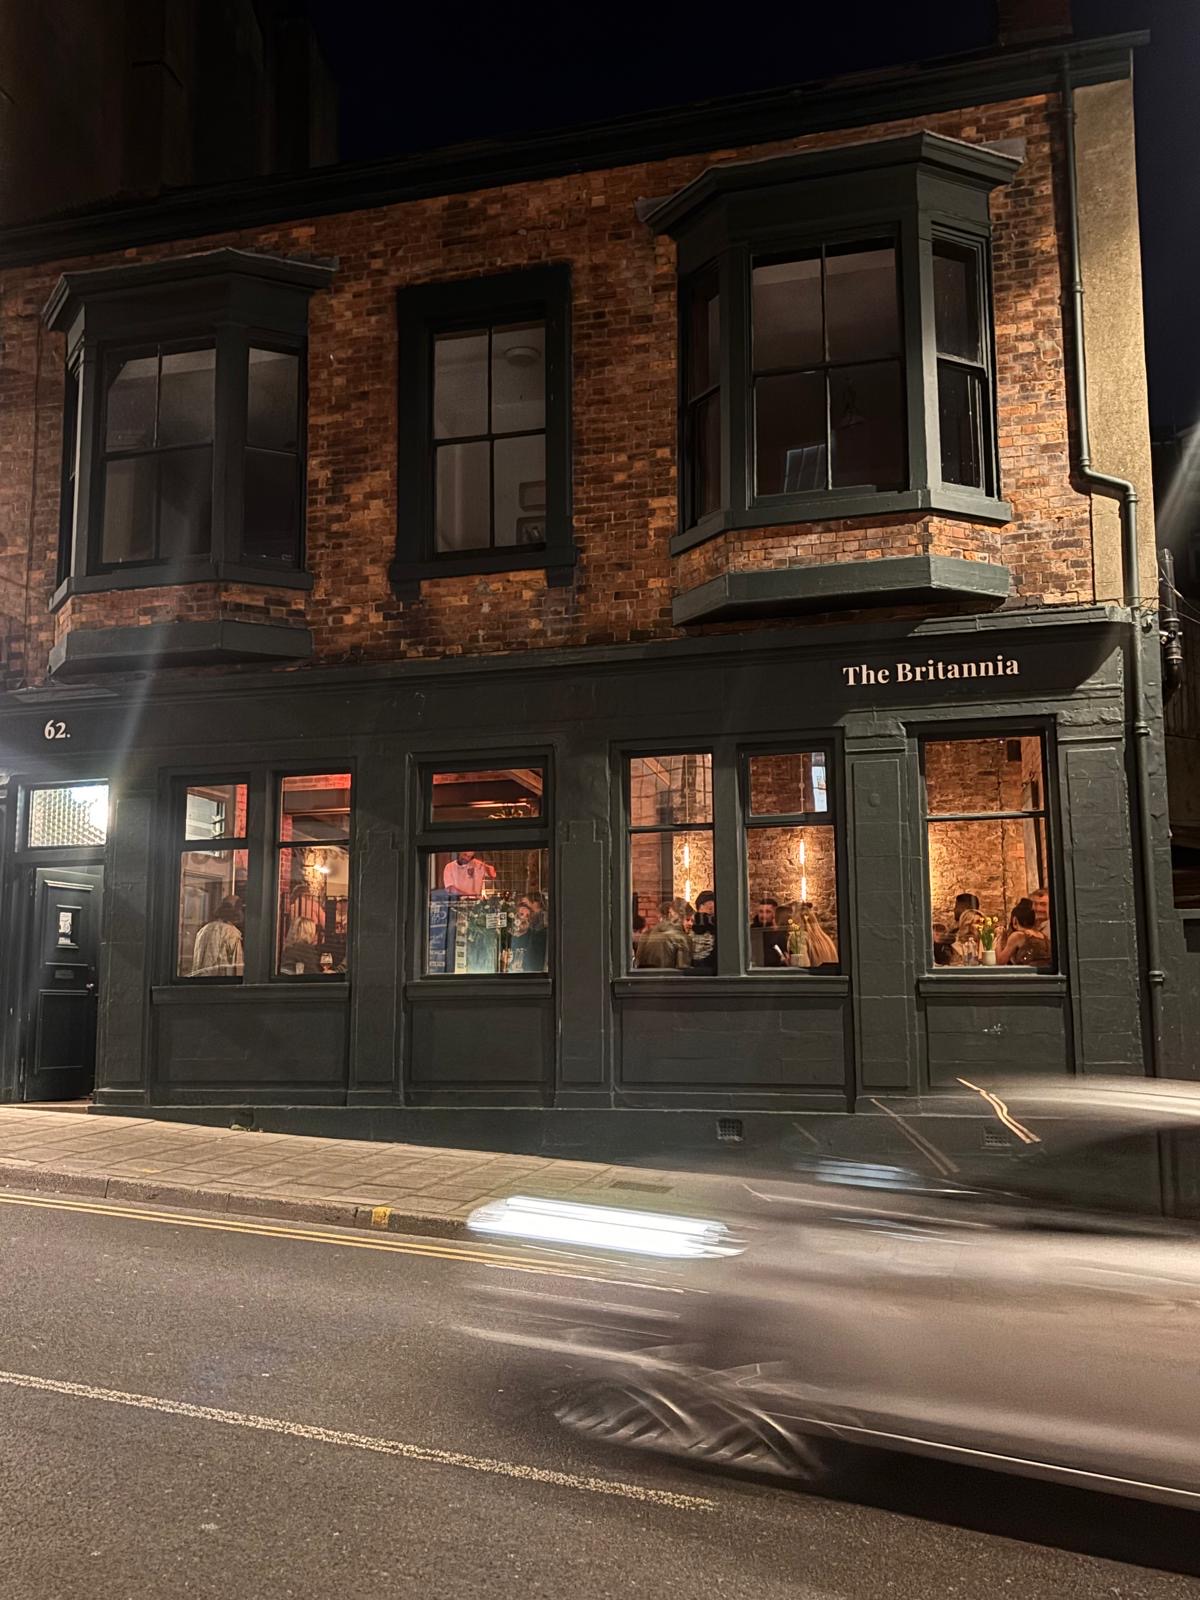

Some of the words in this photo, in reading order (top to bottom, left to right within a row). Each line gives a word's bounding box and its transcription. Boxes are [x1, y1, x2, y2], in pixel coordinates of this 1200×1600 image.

[842, 664, 890, 686] The
[896, 655, 1020, 683] Britannia
[44, 719, 71, 740] 62.
